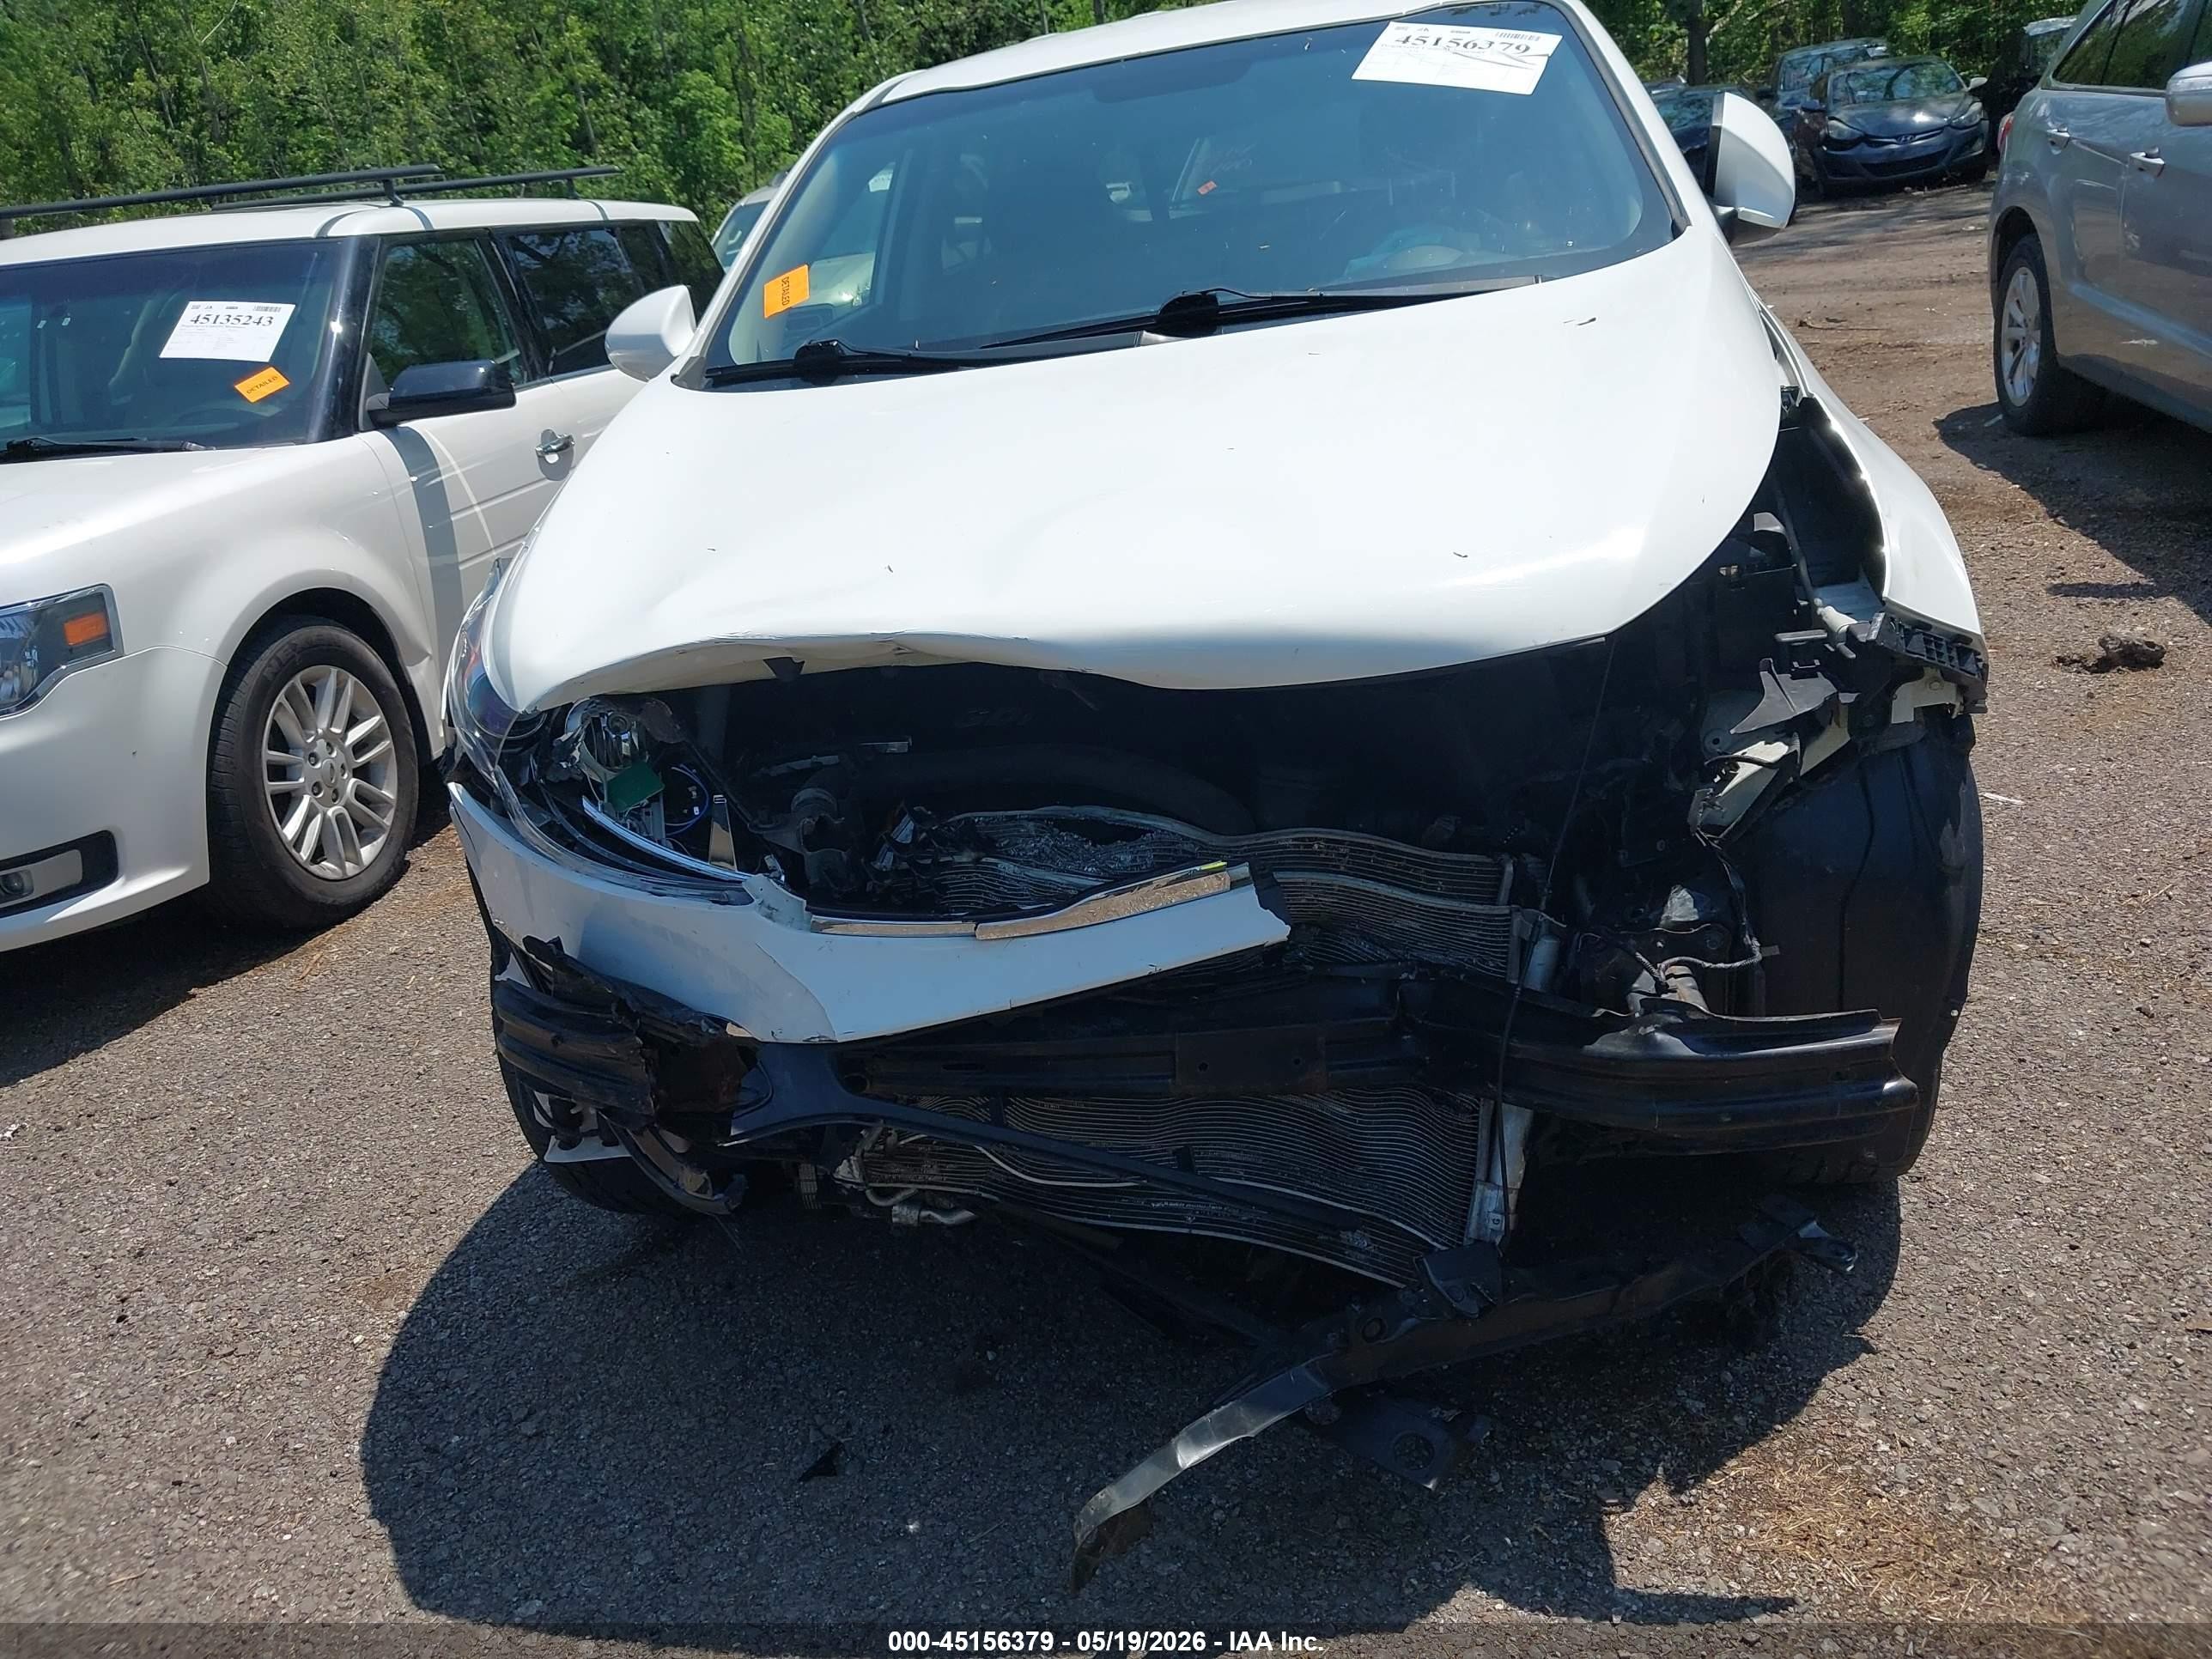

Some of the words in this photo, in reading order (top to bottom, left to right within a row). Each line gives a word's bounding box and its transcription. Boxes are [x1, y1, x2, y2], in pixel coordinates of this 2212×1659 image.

[1395, 34, 1531, 54] 45156379
[190, 313, 274, 326] 45135243
[246, 376, 278, 393] DETAILED
